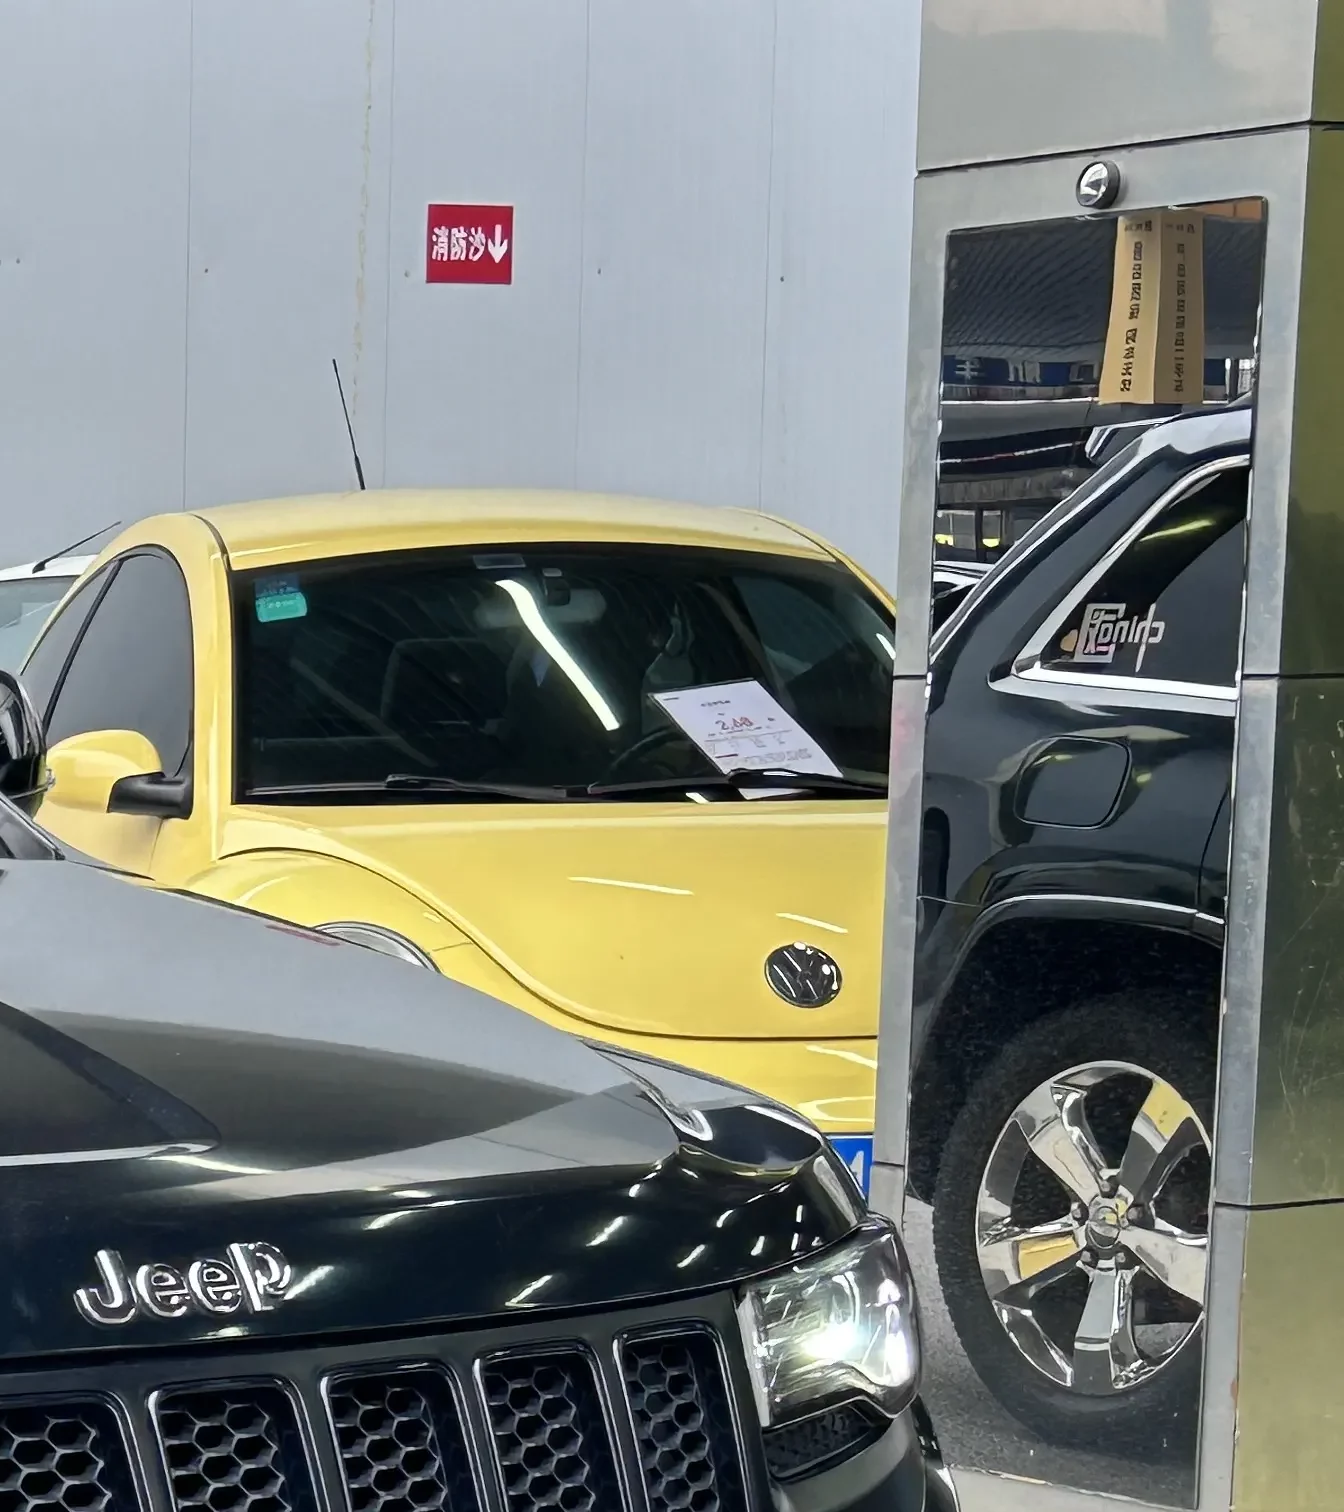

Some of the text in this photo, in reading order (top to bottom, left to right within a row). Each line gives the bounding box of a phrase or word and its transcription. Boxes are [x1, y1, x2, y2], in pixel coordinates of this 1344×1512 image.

[432, 225, 486, 261] 消防沙
[73, 1242, 292, 1325] Jeep
